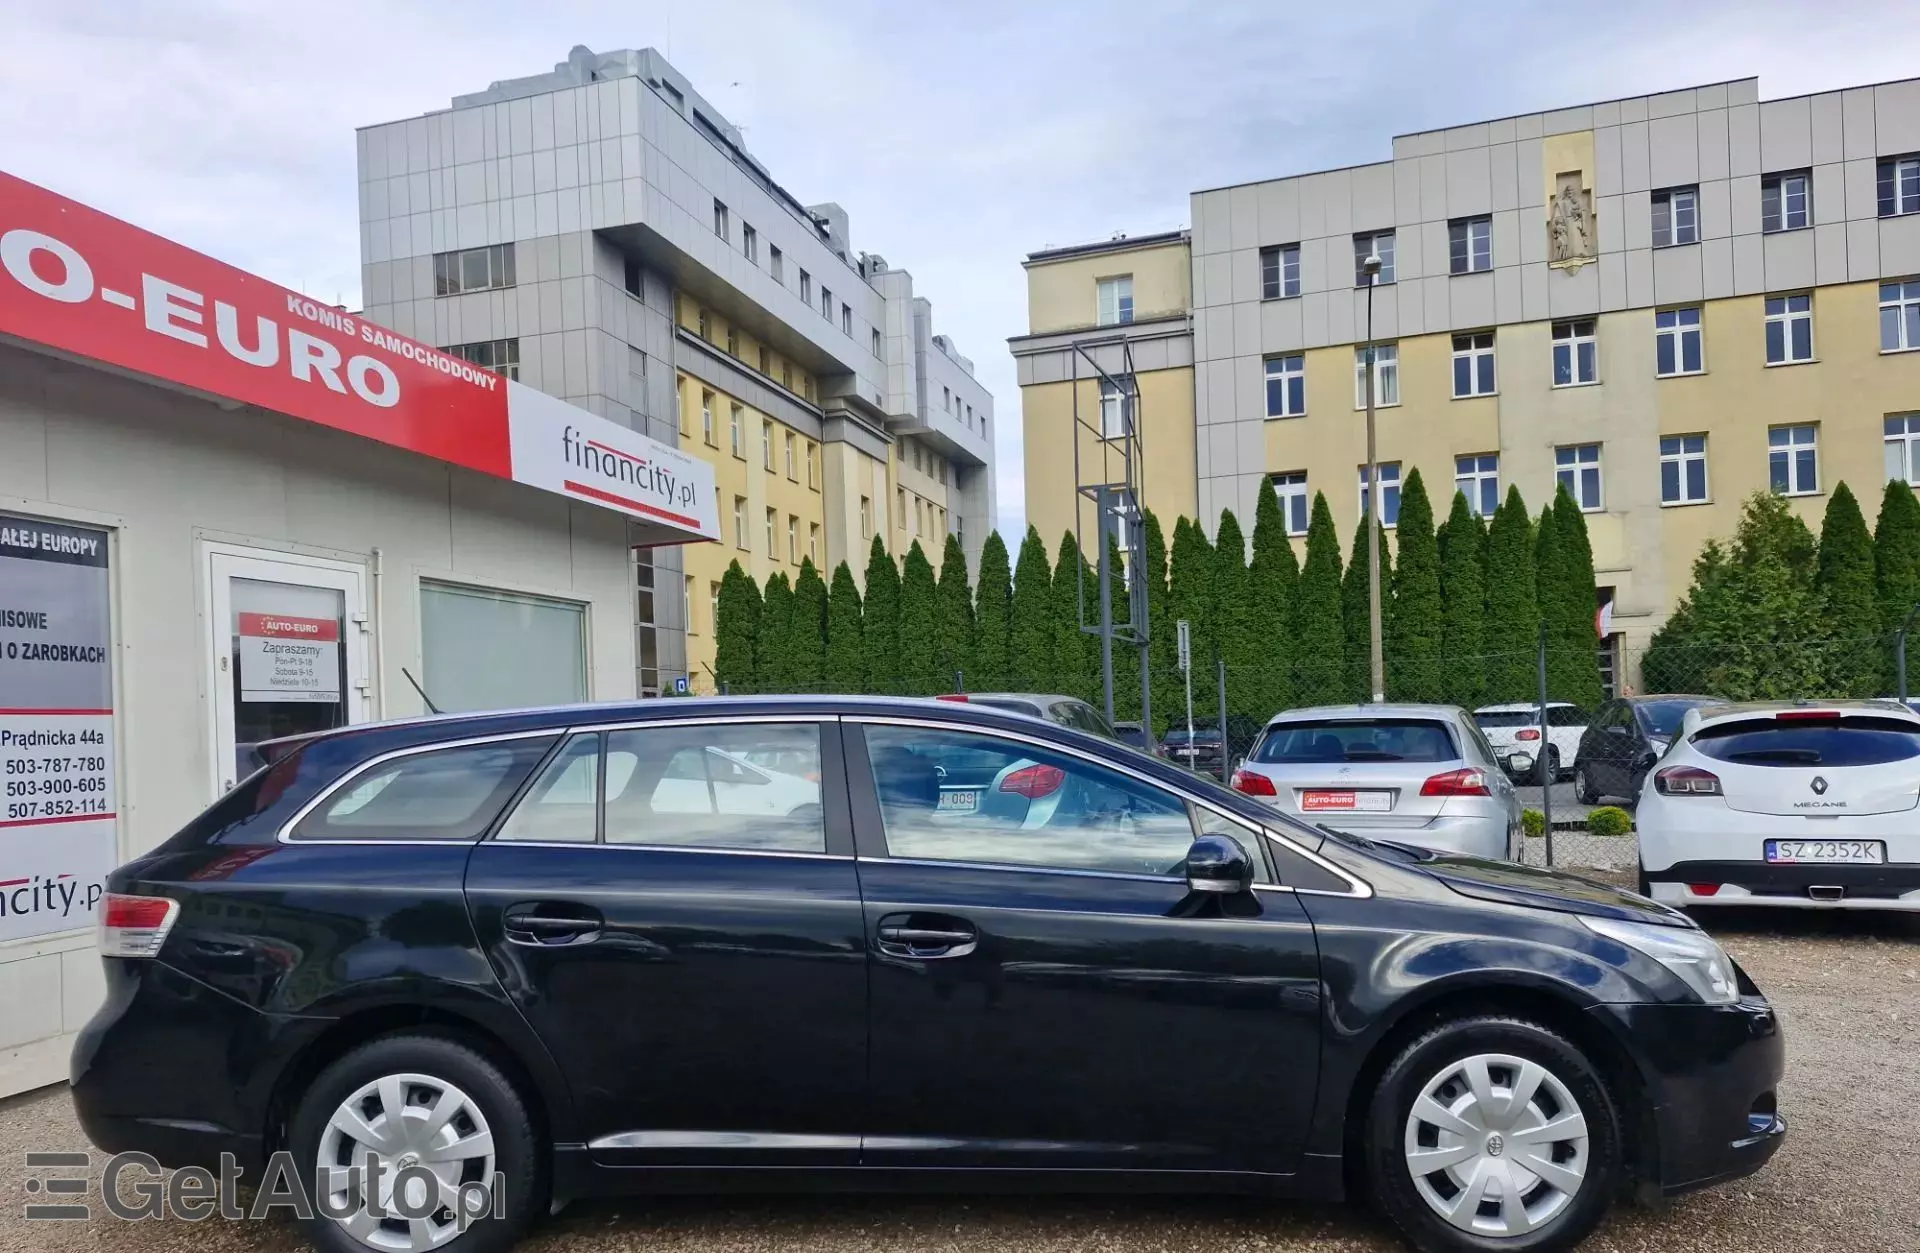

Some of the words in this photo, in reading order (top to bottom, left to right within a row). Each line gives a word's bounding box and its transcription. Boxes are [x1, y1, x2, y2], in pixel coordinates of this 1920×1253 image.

[287, 294, 356, 337] KOMIS
[361, 324, 497, 392] SAMOCHODOWY
[563, 425, 696, 508] financity.pl
[42, 533, 98, 557] EUROPY
[0, 610, 48, 630] ISOWE
[266, 621, 319, 633] AUTO-EURO
[22, 643, 105, 663] ZAROBKACH
[1, 729, 76, 750] Prądnicka
[80, 729, 104, 745] 44a
[6, 757, 105, 775] 503-787-780
[7, 778, 106, 797] 503-900-605
[8, 798, 107, 819] 507-852-114
[1307, 796, 1354, 804] AUTO-EURO
[1780, 842, 1807, 858] SZ
[1813, 842, 1876, 859] 2352K
